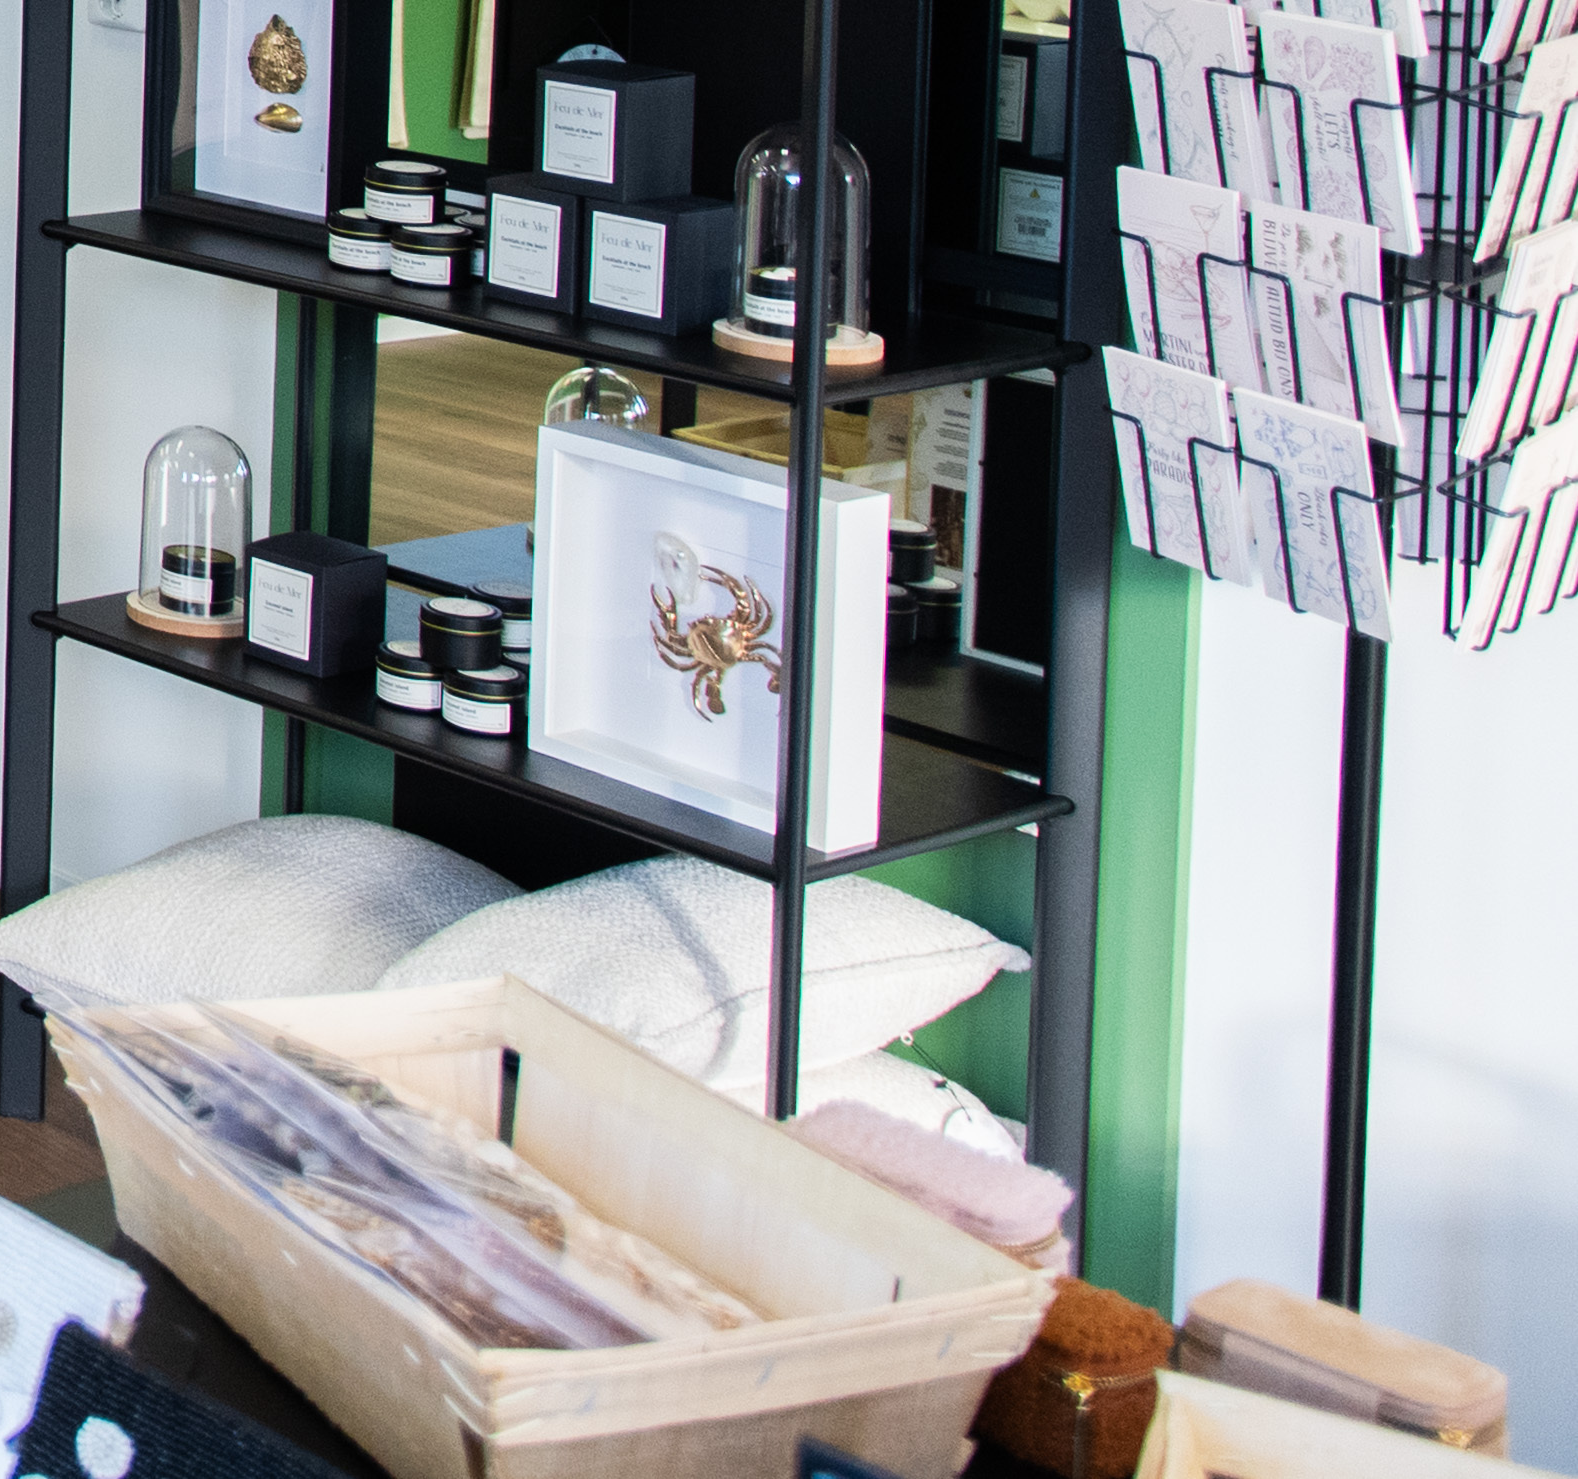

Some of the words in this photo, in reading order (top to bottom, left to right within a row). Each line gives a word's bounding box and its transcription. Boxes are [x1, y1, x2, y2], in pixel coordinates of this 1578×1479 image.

[1324, 112, 1341, 150] LET'S
[1266, 286, 1284, 335] ALTIJD
[1143, 328, 1193, 355] MRTINI
[1272, 339, 1286, 364] BIJ
[1280, 366, 1293, 397] ONS
[1297, 491, 1315, 531] ONLY
